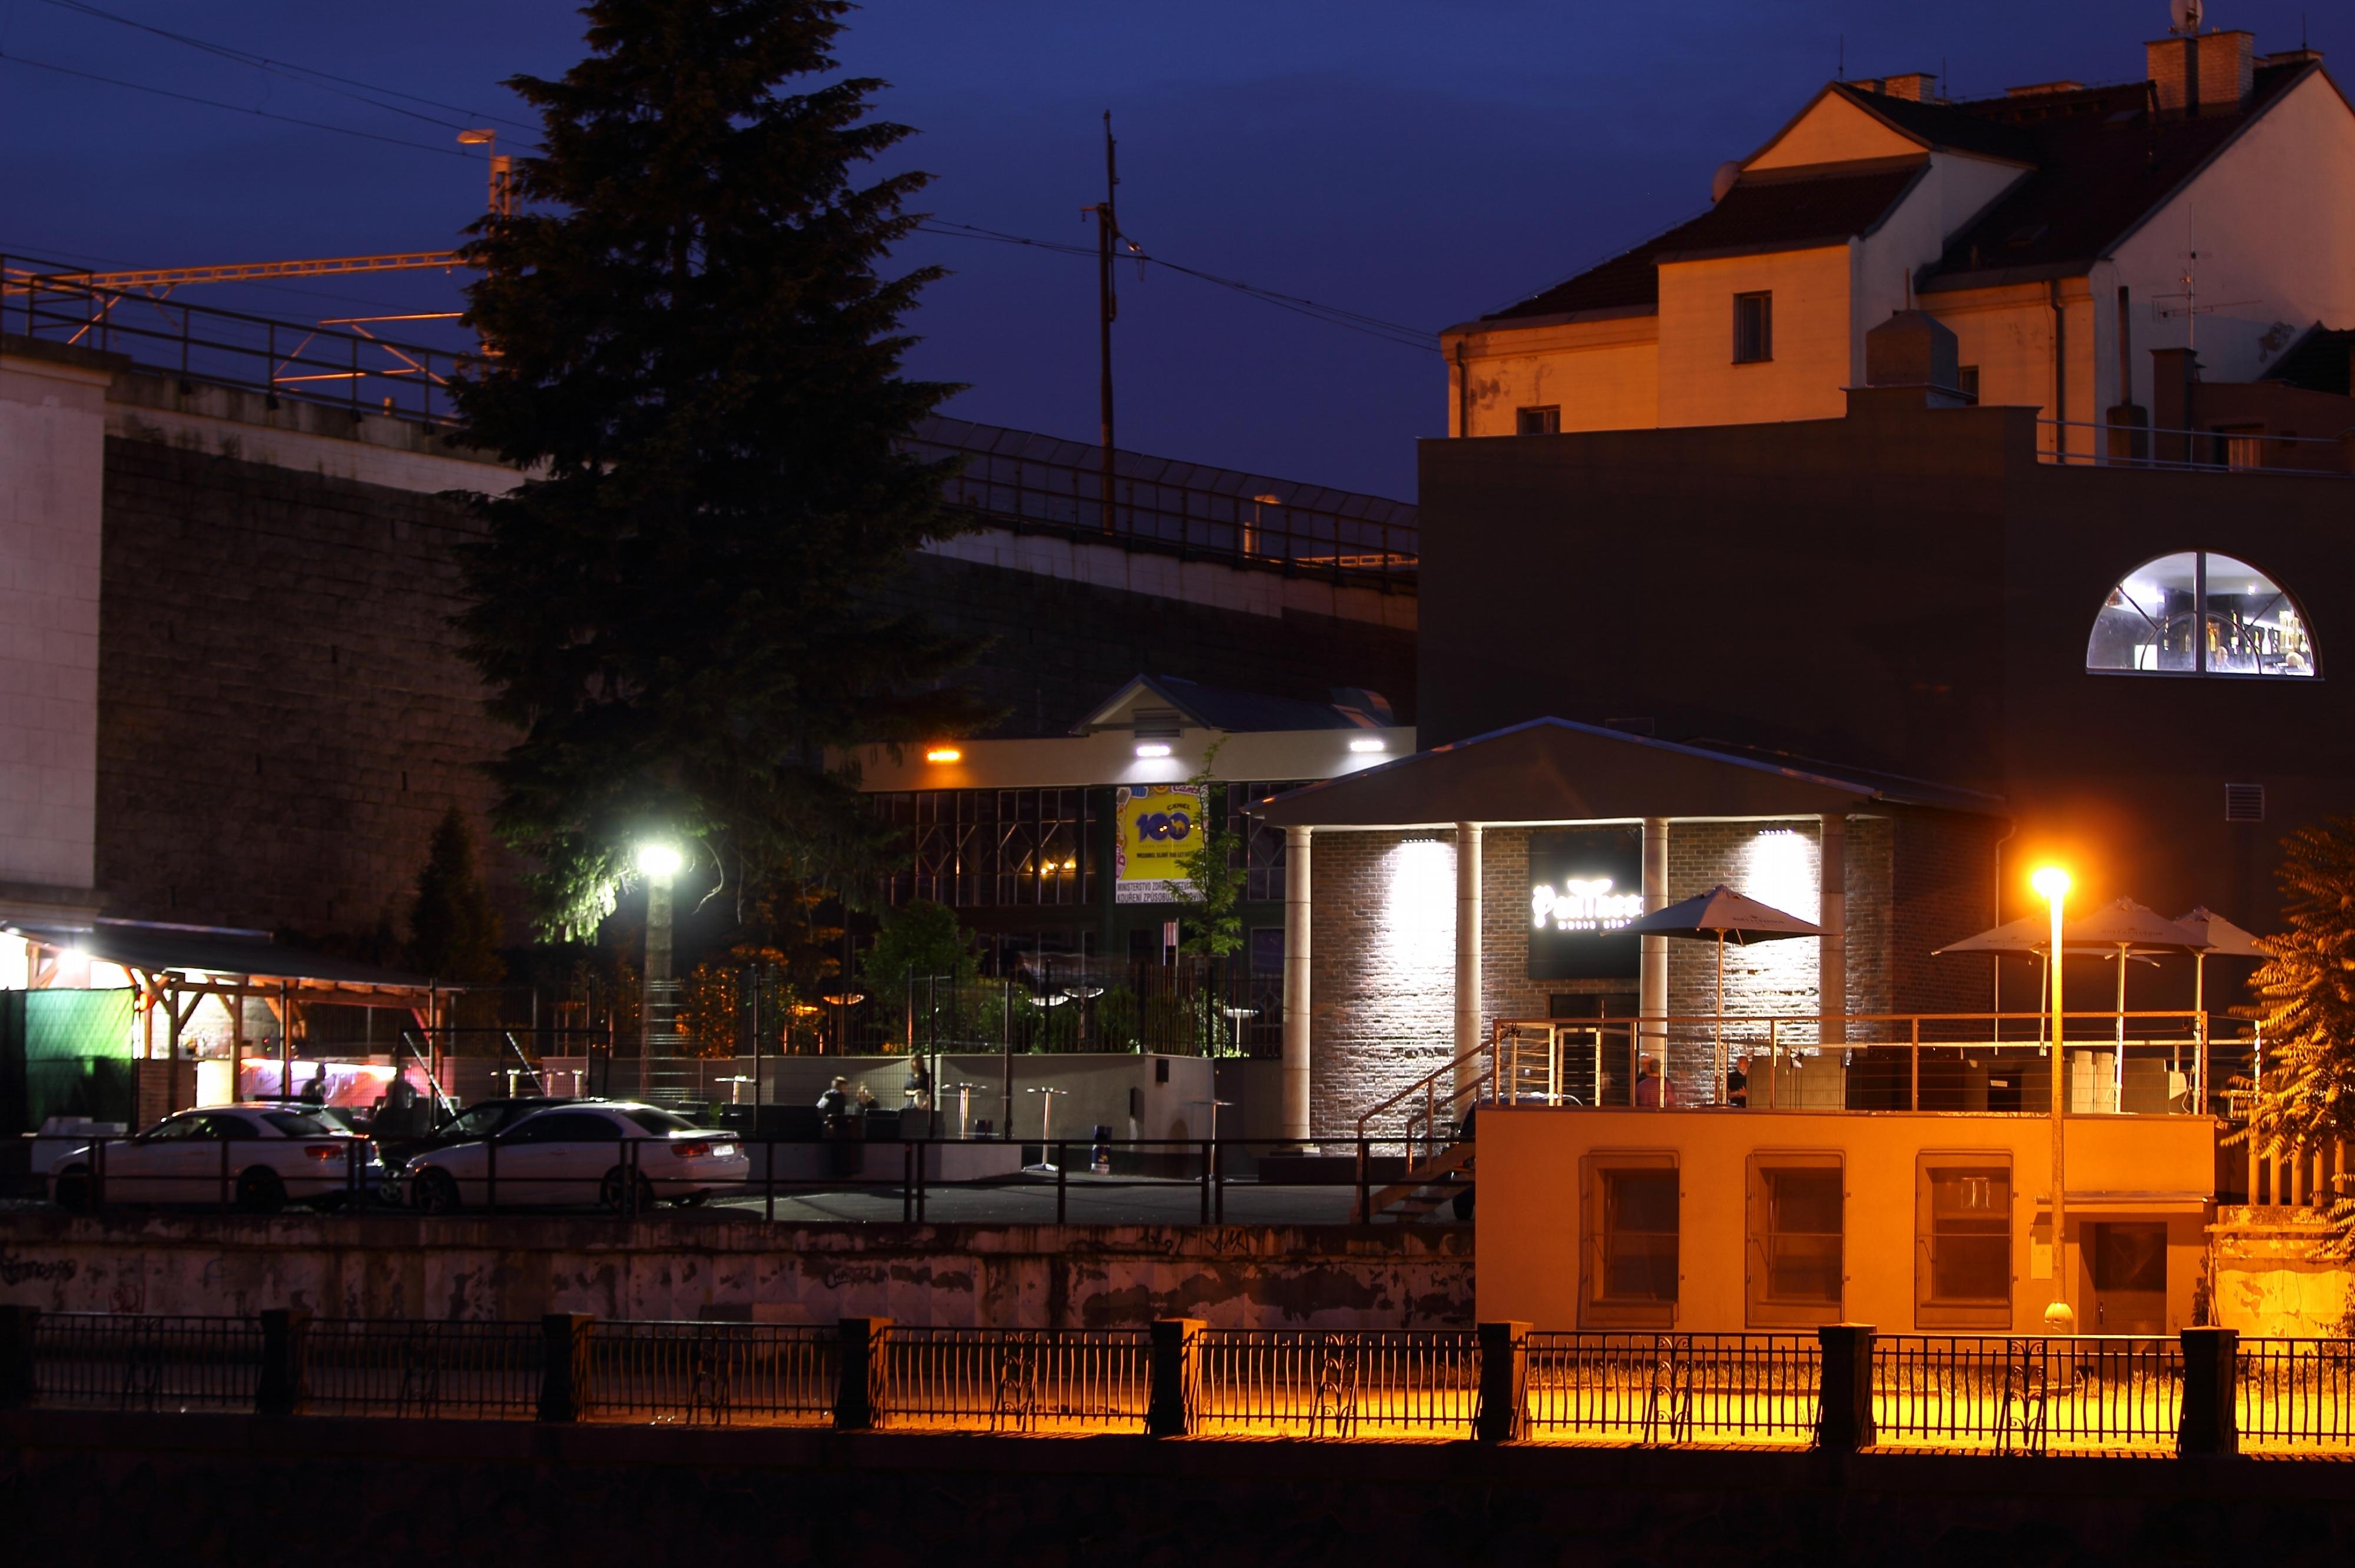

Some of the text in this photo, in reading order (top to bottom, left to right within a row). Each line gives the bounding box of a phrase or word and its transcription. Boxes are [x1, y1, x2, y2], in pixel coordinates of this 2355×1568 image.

[1136, 811, 1190, 841] 100
[1117, 882, 1152, 892] MINISTERSTVO
[1117, 892, 1142, 903] KOUŘENÍ
